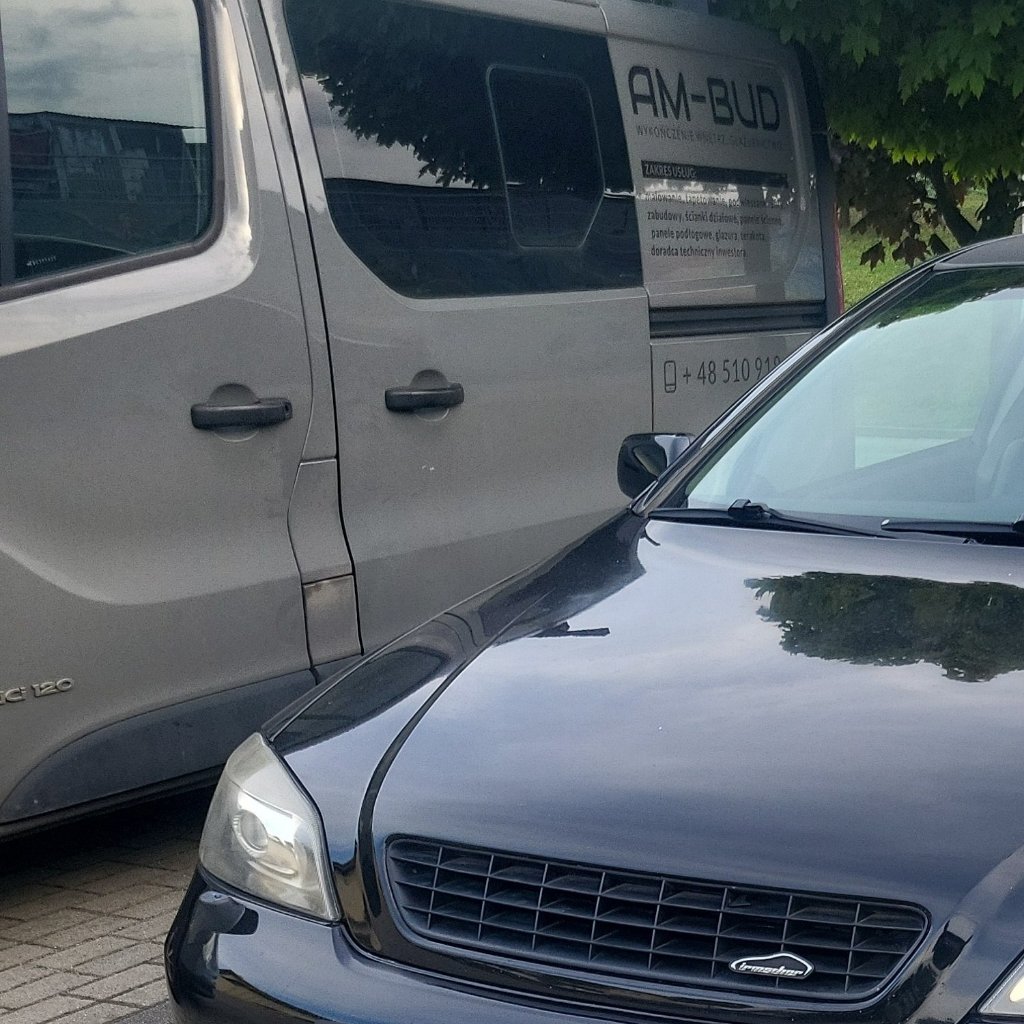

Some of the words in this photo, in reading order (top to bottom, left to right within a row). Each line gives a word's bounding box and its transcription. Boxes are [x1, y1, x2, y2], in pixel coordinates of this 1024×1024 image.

[628, 65, 780, 131] AM-BUD
[644, 164, 672, 177] ZAKRES
[651, 229, 675, 240] panele
[651, 245, 679, 257] doradca
[680, 246, 715, 259] techniczny
[722, 358, 750, 383] 510
[31, 677, 73, 698] 120
